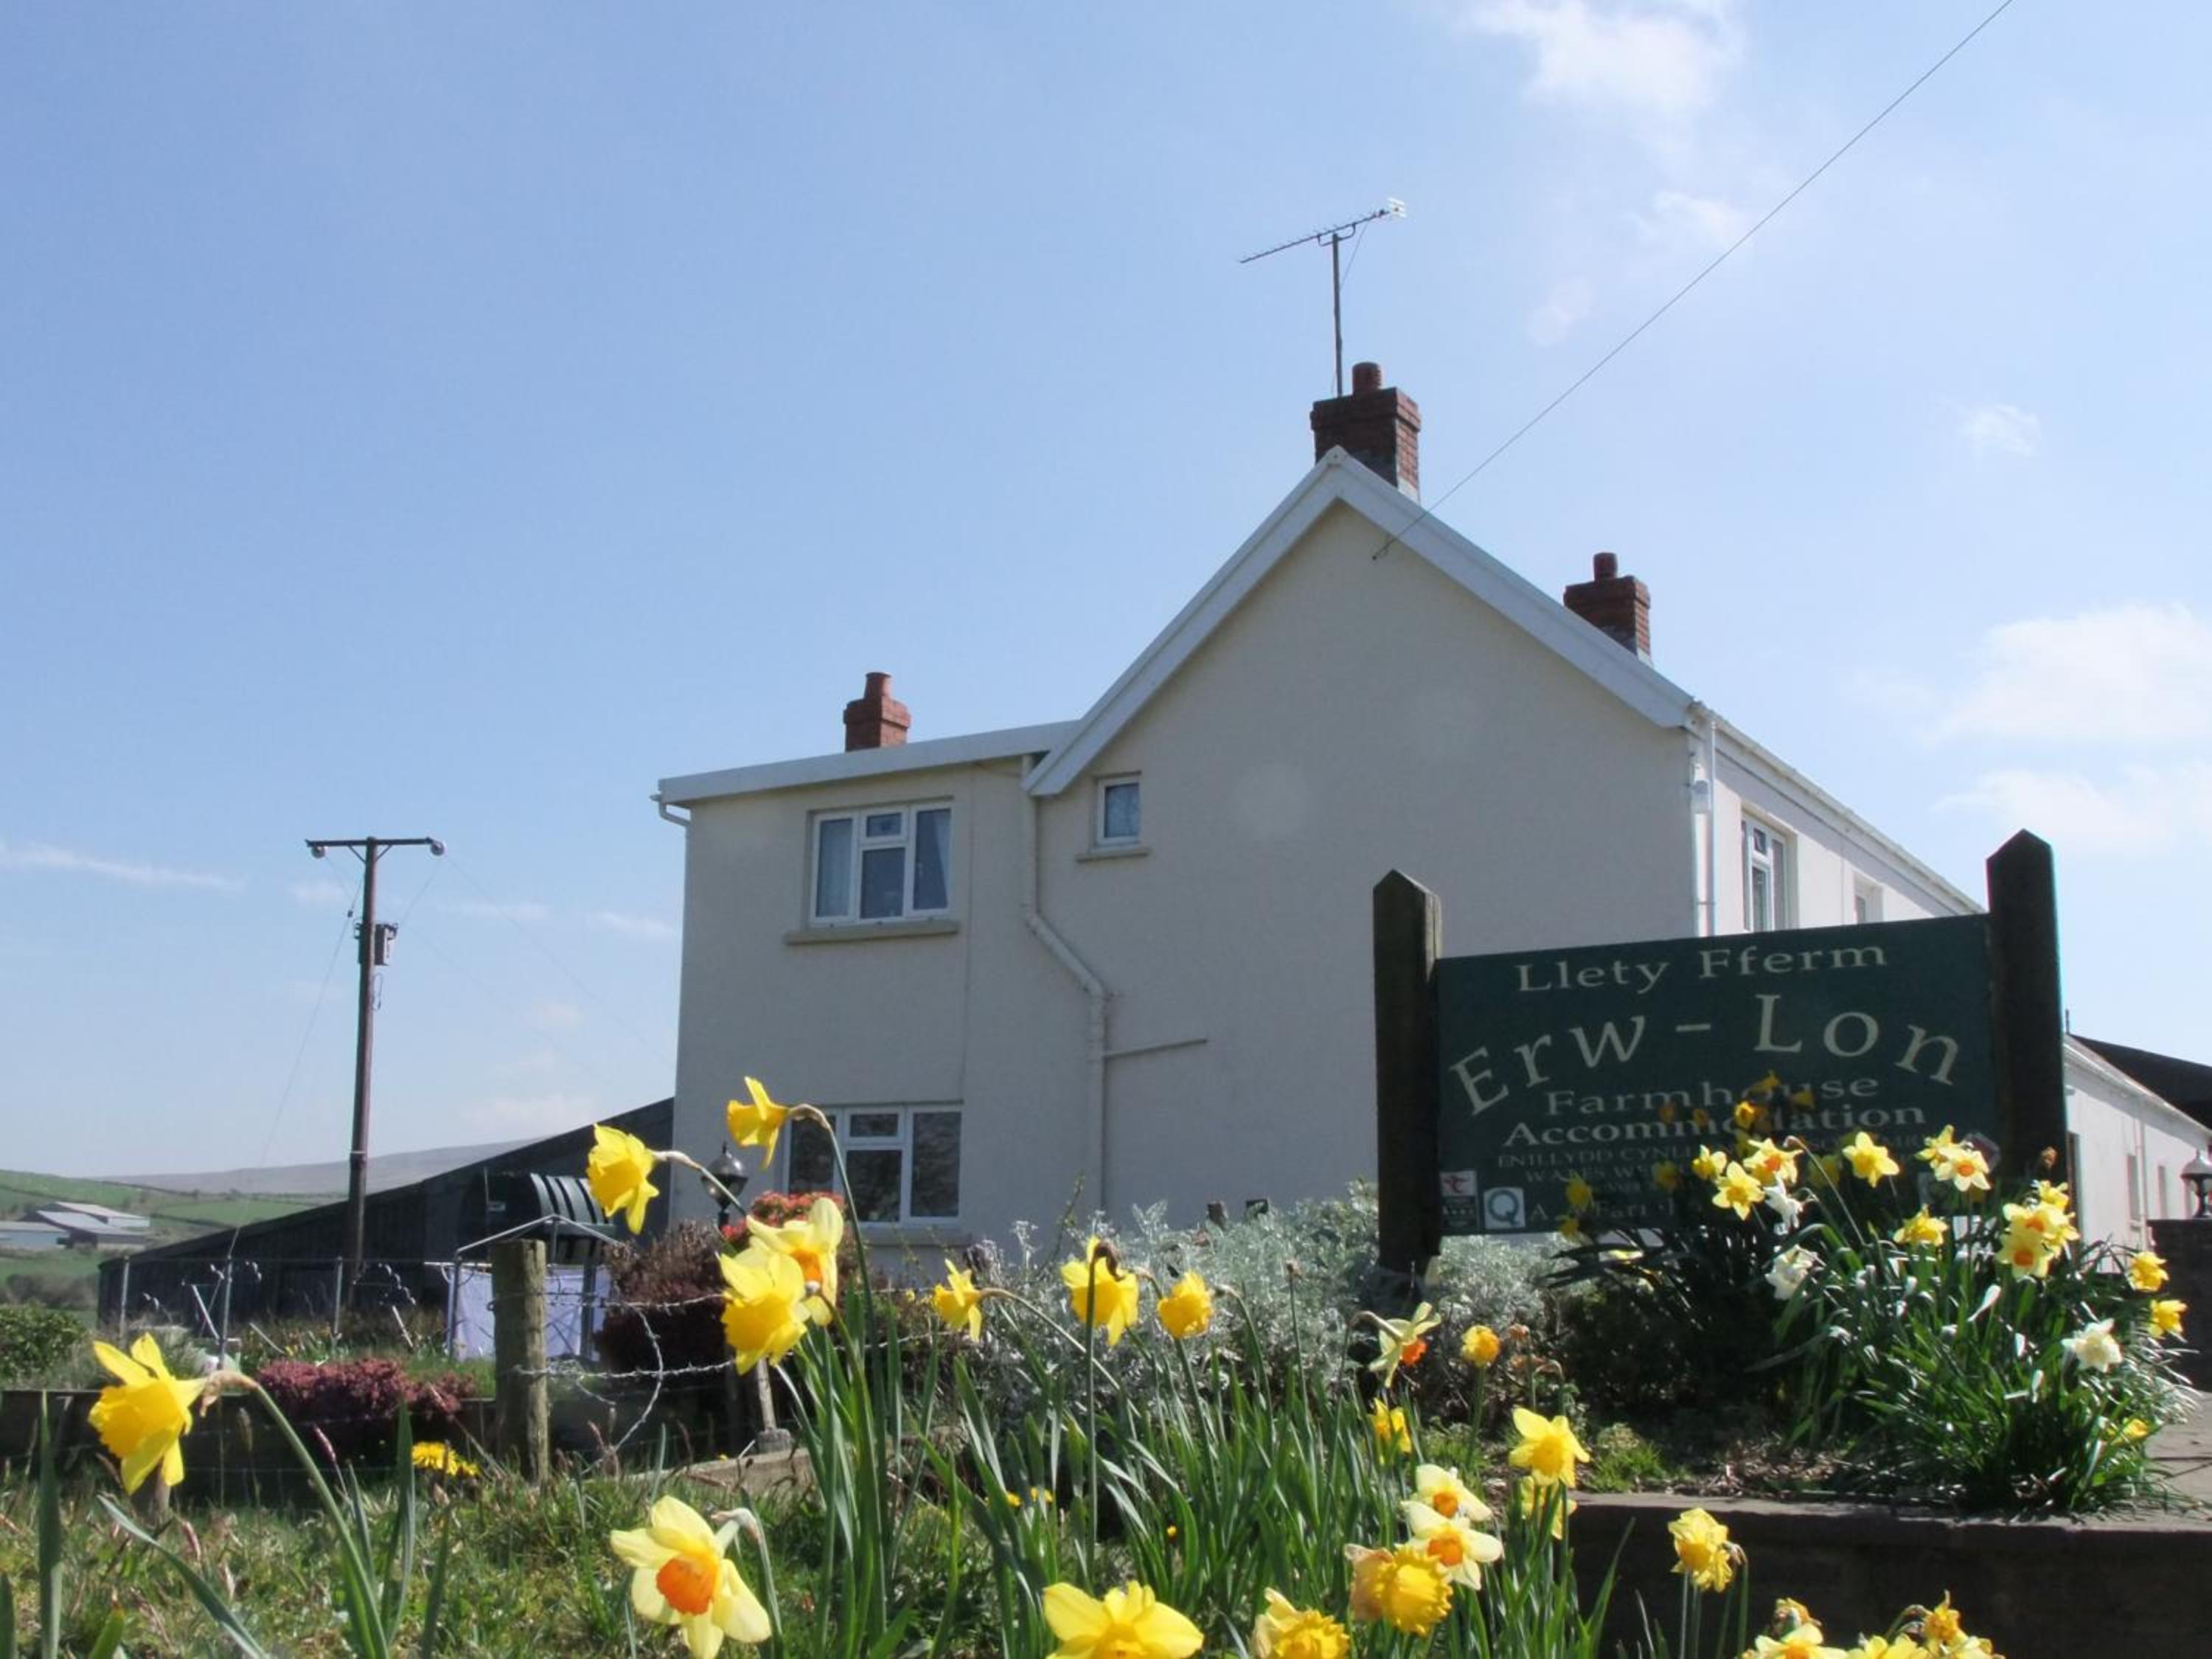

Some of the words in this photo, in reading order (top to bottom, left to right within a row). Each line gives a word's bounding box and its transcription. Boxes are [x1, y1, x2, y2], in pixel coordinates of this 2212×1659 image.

[1514, 960, 1671, 995] Llety
[1698, 945, 1888, 979] Fferm
[1448, 1015, 1646, 1116] Erw
[1753, 993, 1960, 1085] Lon
